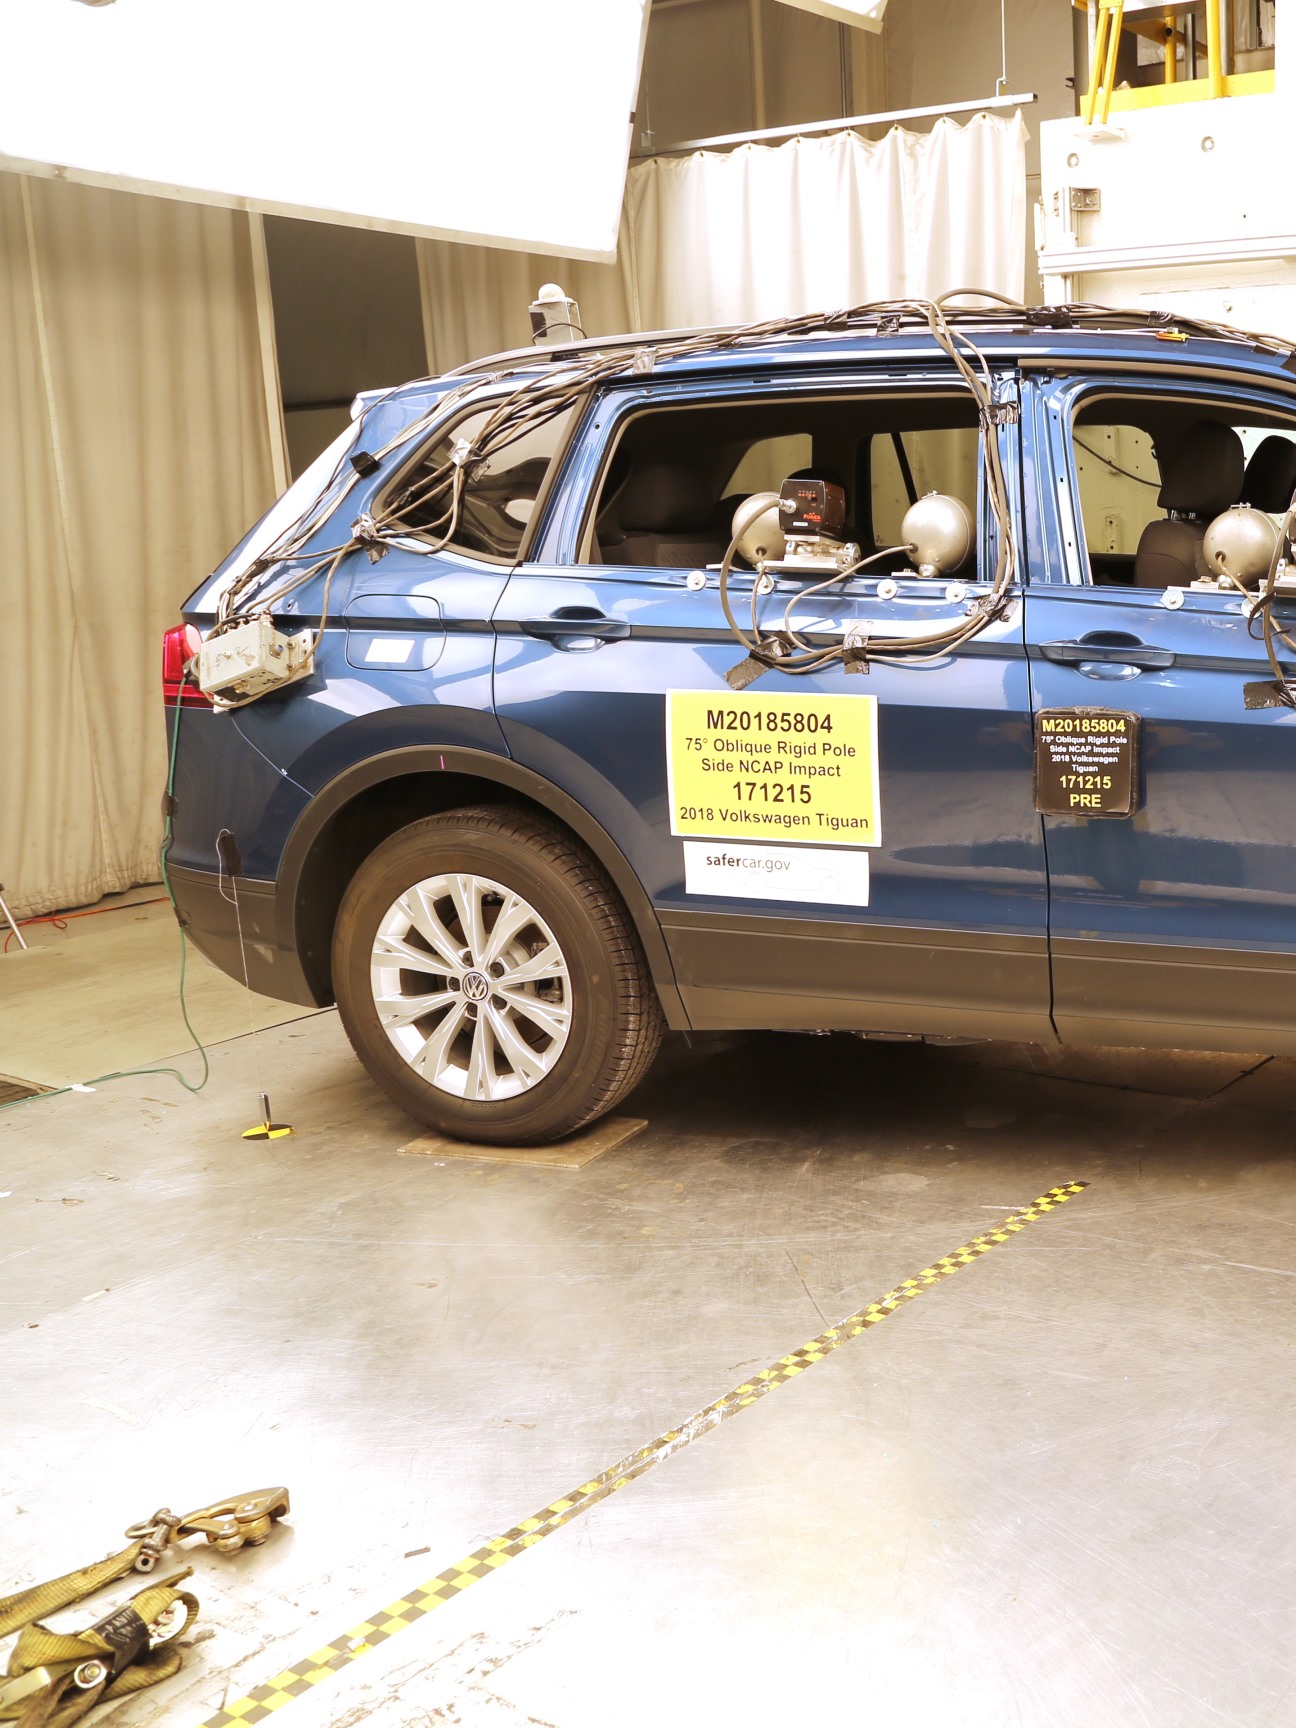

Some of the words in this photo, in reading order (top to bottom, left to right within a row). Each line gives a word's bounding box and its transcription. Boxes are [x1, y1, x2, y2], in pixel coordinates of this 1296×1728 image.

[707, 710, 833, 733] M20185804
[1041, 719, 1125, 732] M20185804
[714, 739, 771, 756] Oblique
[778, 741, 816, 758] Rigid
[823, 743, 855, 757] Pole
[1055, 736, 1085, 744] Oblique
[1087, 736, 1108, 745] Rigid
[1093, 746, 1120, 754] Impact
[1051, 755, 1069, 763] 2018
[1070, 755, 1118, 764] Volkswagen
[702, 758, 733, 772] Side
[740, 760, 783, 774] NCAP
[789, 762, 841, 778] Impact
[1071, 764, 1098, 773] Tiguan
[1059, 775, 1111, 789] 171215
[733, 782, 811, 804] 171215
[1069, 794, 1101, 807] PRE
[680, 807, 714, 821] 2018
[719, 809, 810, 827] Volkswagen
[816, 813, 868, 830] Tiguan
[706, 854, 790, 872] safercar.gov
[464, 973, 487, 1000] VW
